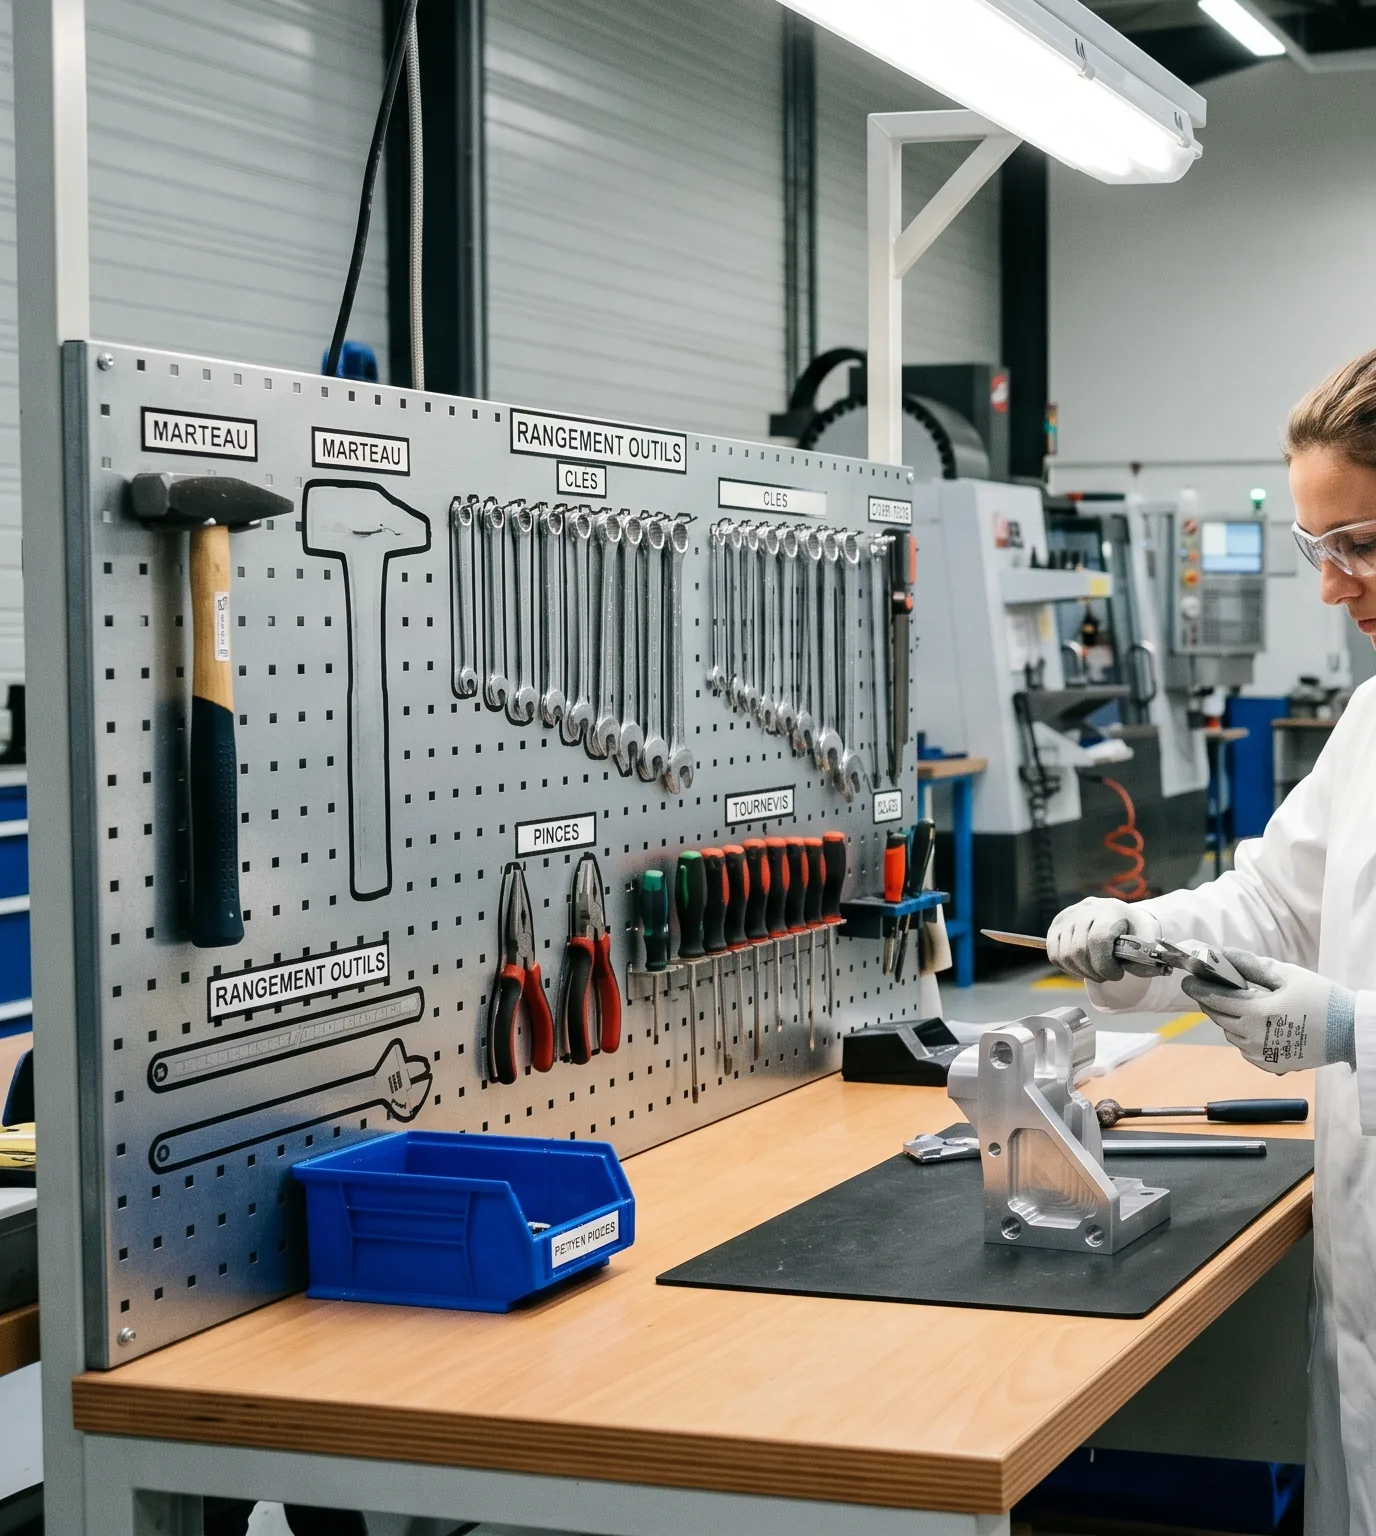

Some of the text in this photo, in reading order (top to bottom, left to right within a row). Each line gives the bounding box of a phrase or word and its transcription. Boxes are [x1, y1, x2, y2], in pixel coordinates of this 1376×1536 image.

[153, 420, 248, 450] MARTEAU
[517, 421, 682, 463] RANGEMENT OUTILS
[322, 438, 401, 466] MARTEAU
[763, 491, 788, 508] CLES
[732, 797, 789, 817] TOURNEVIS
[533, 823, 580, 846] PINCES
[215, 952, 386, 1008] RANGEMENT OUTILS
